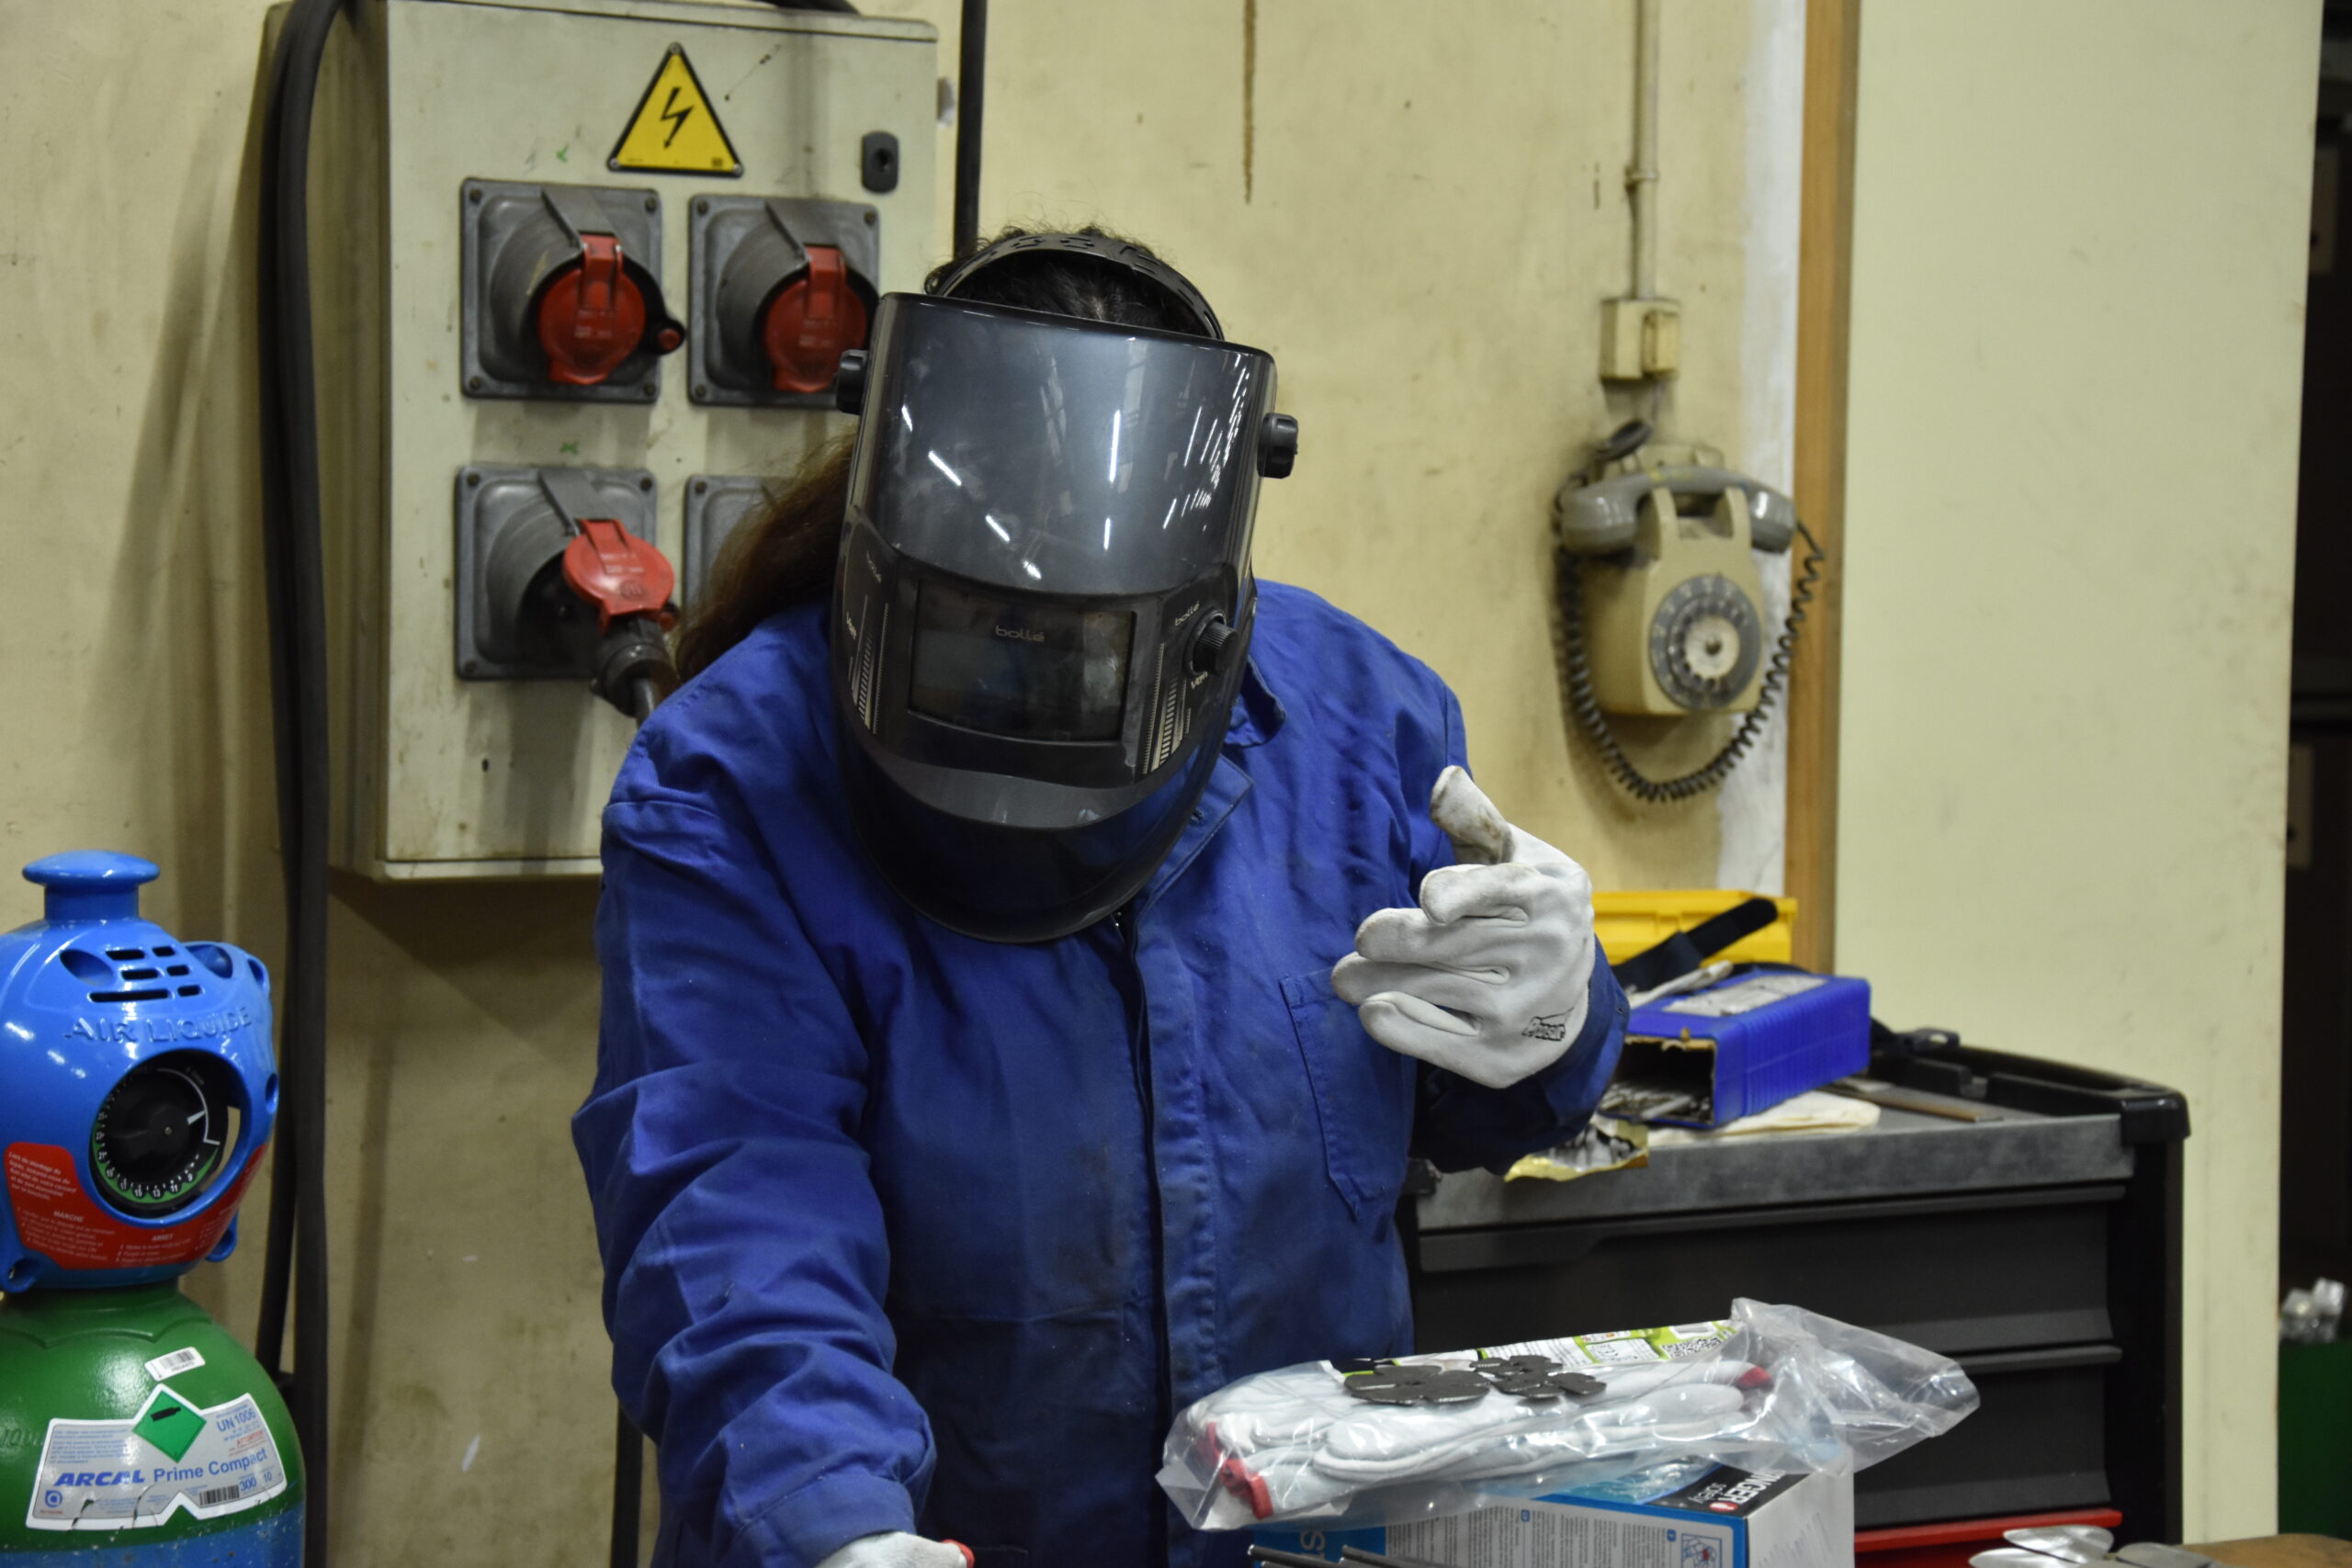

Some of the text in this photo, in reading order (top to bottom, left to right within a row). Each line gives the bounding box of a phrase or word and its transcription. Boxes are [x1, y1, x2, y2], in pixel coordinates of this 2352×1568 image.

[995, 625, 1045, 643] bollé
[63, 1007, 252, 1043] AIR LIQUIDE
[216, 1418, 235, 1432] UN
[53, 1470, 145, 1486] ARCAL
[153, 1467, 204, 1483] Prime
[209, 1448, 267, 1475] Compact
[240, 1477, 257, 1492] 300
